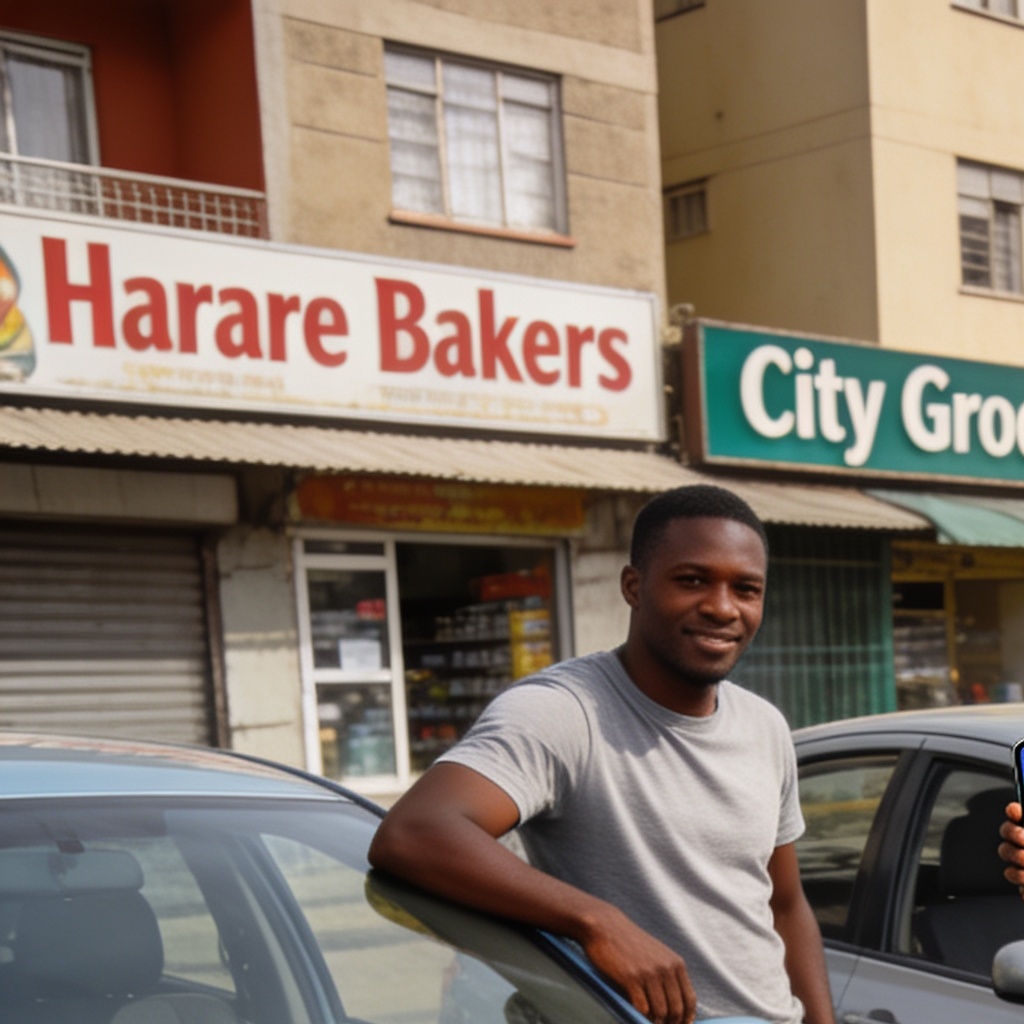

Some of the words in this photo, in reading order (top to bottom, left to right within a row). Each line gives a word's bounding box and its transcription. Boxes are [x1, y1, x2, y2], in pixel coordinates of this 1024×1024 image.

[41, 236, 349, 368] Harare
[374, 277, 634, 393] Bakers
[738, 344, 886, 467] City
